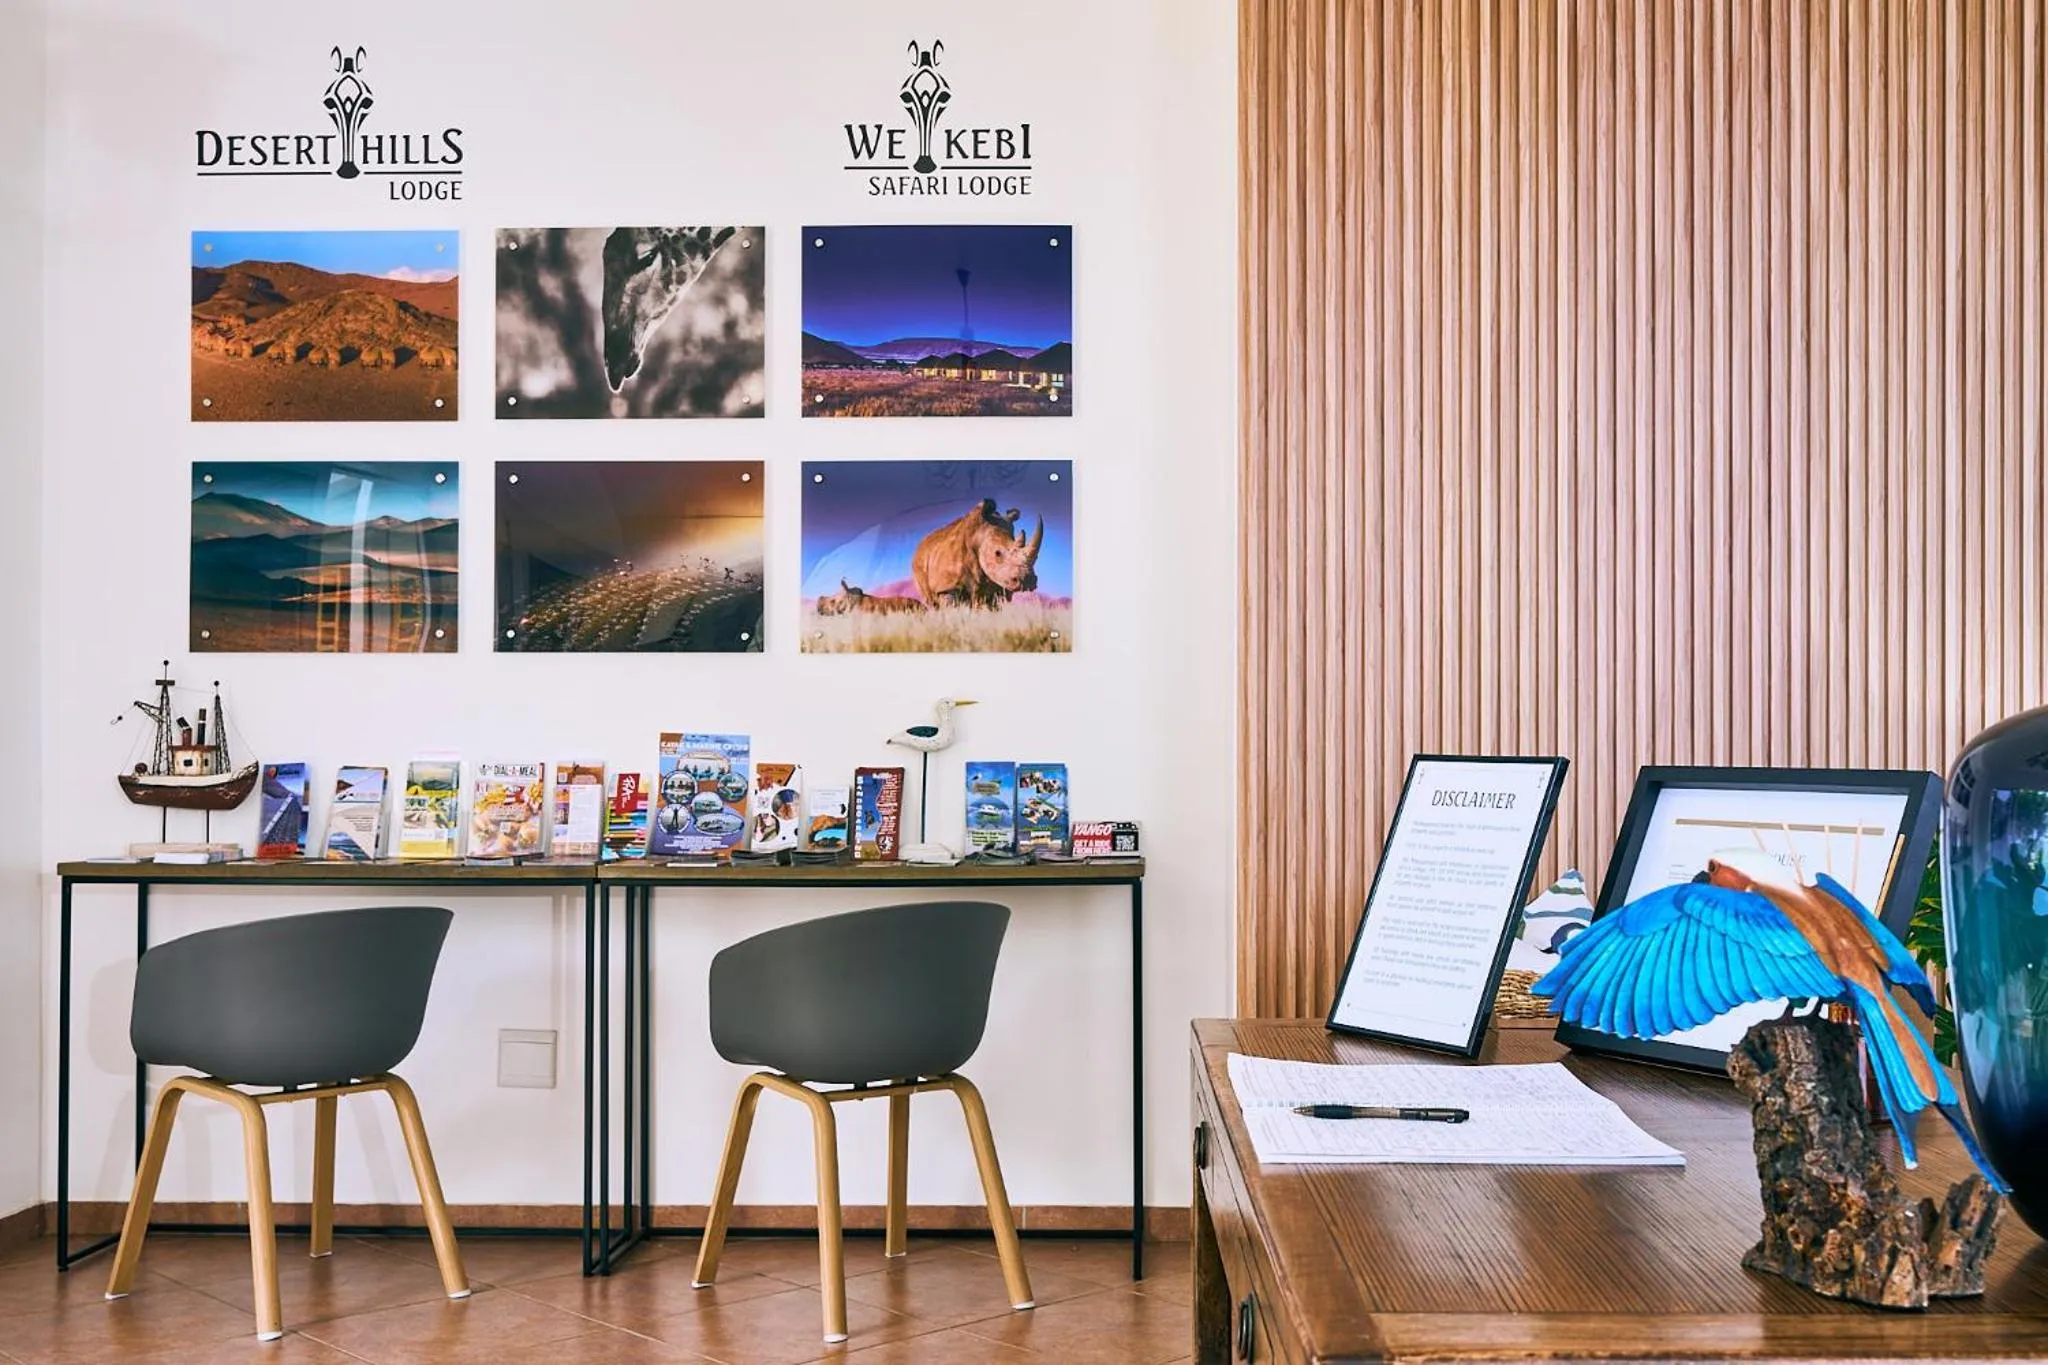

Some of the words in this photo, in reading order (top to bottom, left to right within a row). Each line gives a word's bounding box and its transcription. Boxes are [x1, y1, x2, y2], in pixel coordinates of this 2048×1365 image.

[196, 130, 336, 166] DESERT
[361, 128, 463, 165] HILLS
[843, 124, 906, 160] WE
[945, 123, 1031, 160] KEBI
[390, 181, 463, 200] LODGE
[868, 176, 948, 196] SAFARI
[958, 176, 1032, 195] LODGE
[1431, 789, 1517, 810] DISCLAIMER
[1073, 823, 1112, 836] YANGO
